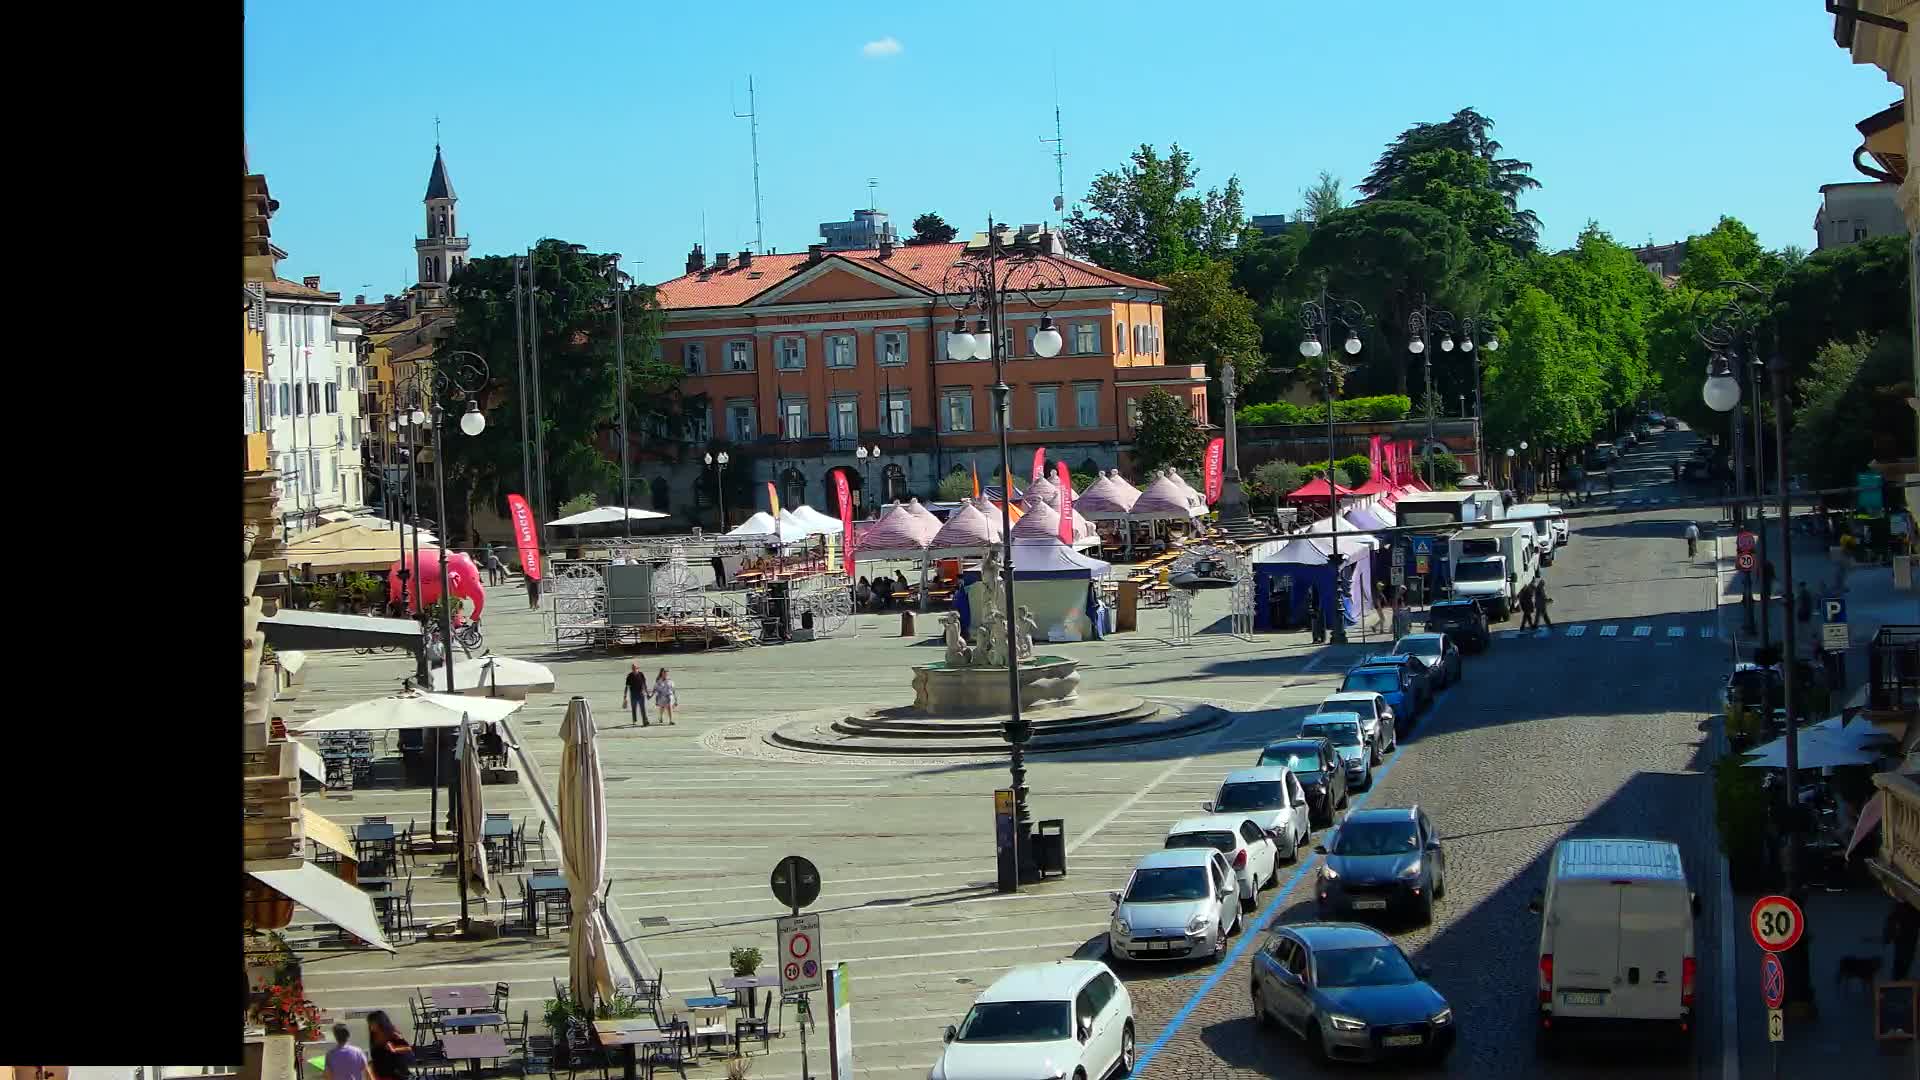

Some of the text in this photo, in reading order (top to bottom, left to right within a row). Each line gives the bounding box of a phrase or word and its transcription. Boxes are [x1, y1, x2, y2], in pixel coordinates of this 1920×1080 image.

[1209, 445, 1219, 475] PUGLIA
[1827, 602, 1841, 621] P
[1761, 911, 1790, 937] 30
